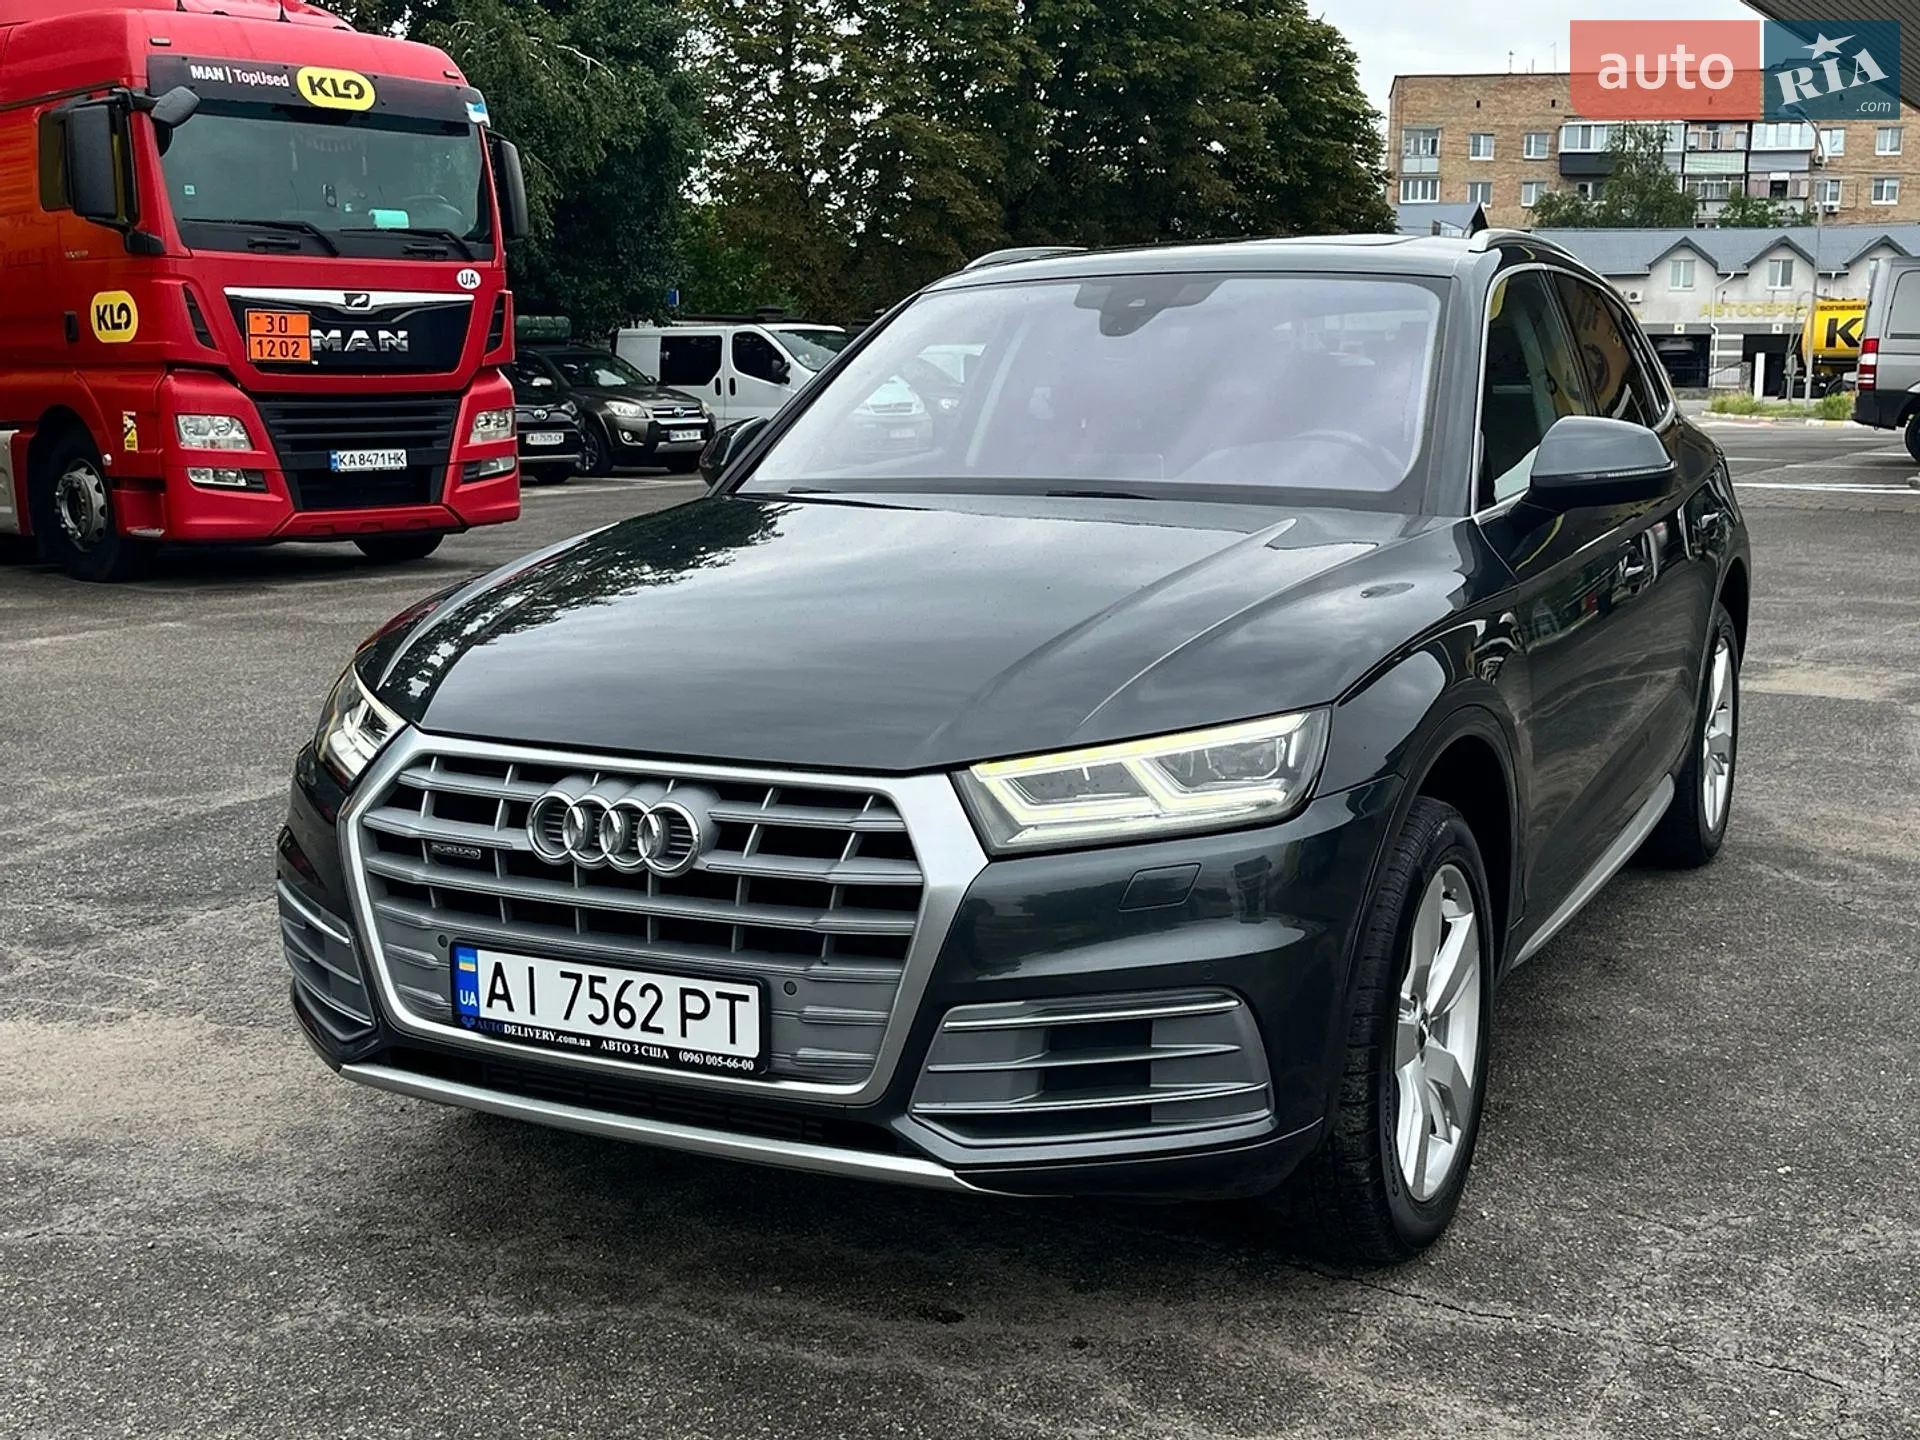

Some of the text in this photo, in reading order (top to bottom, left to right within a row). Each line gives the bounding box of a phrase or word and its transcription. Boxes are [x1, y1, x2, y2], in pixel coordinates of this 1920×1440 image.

[190, 65, 290, 87] MAN TopUsed
[461, 273, 477, 286] UA
[265, 315, 288, 333] 30
[256, 339, 301, 358] 1202
[310, 329, 409, 352] MAN
[459, 989, 478, 1007] UA
[486, 961, 750, 1045] AI 7562 PT
[600, 1039, 631, 1054] АВТО
[641, 1045, 669, 1060] США
[678, 1050, 704, 1066] (096)
[705, 1053, 755, 1072] 005-66-00
